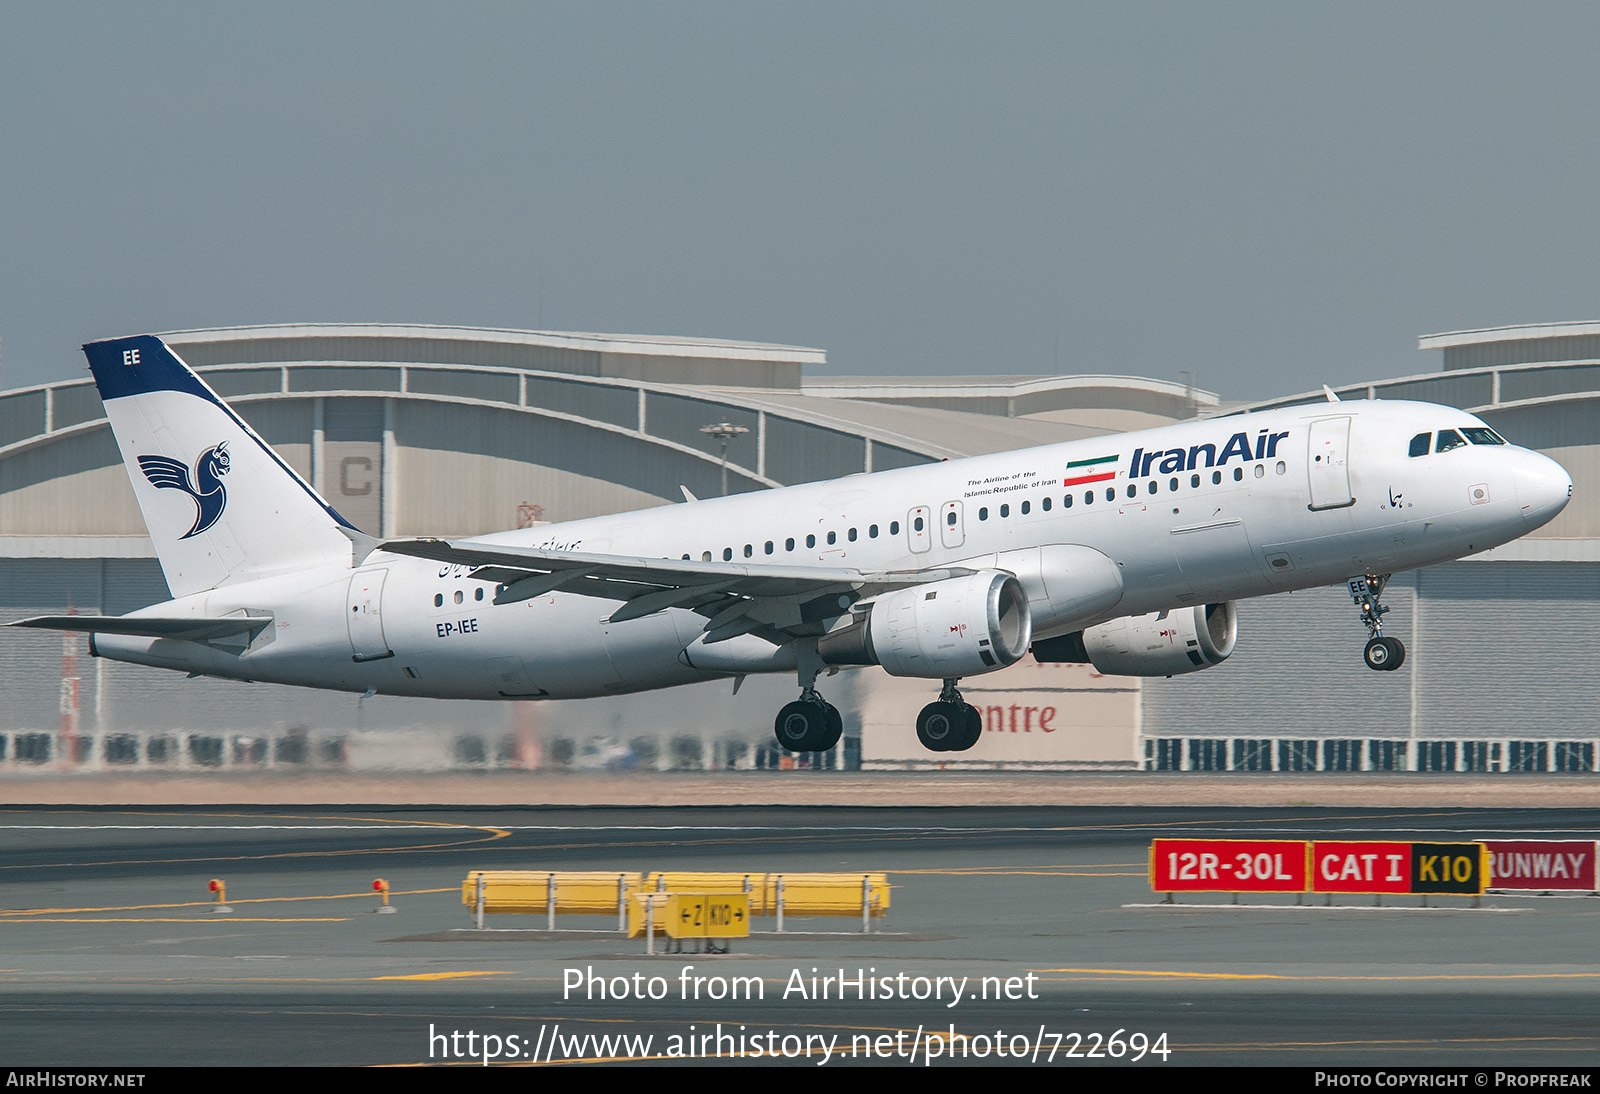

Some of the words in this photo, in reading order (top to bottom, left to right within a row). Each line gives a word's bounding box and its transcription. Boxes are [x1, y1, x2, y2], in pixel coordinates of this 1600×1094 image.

[122, 349, 141, 366] EE
[1128, 428, 1290, 479] IranAir
[341, 456, 372, 496] C
[983, 475, 1009, 484] Airline
[964, 489, 992, 498] Islamic
[993, 483, 1028, 493] Republic
[1031, 480, 1040, 488] of
[1350, 580, 1366, 593] EE
[436, 618, 479, 638] EP-IEE
[1168, 852, 1293, 880] 12R-30L
[1320, 853, 1378, 881] CAT
[1385, 854, 1404, 882] I
[1419, 855, 1472, 882] K10
[693, 904, 703, 927] Z
